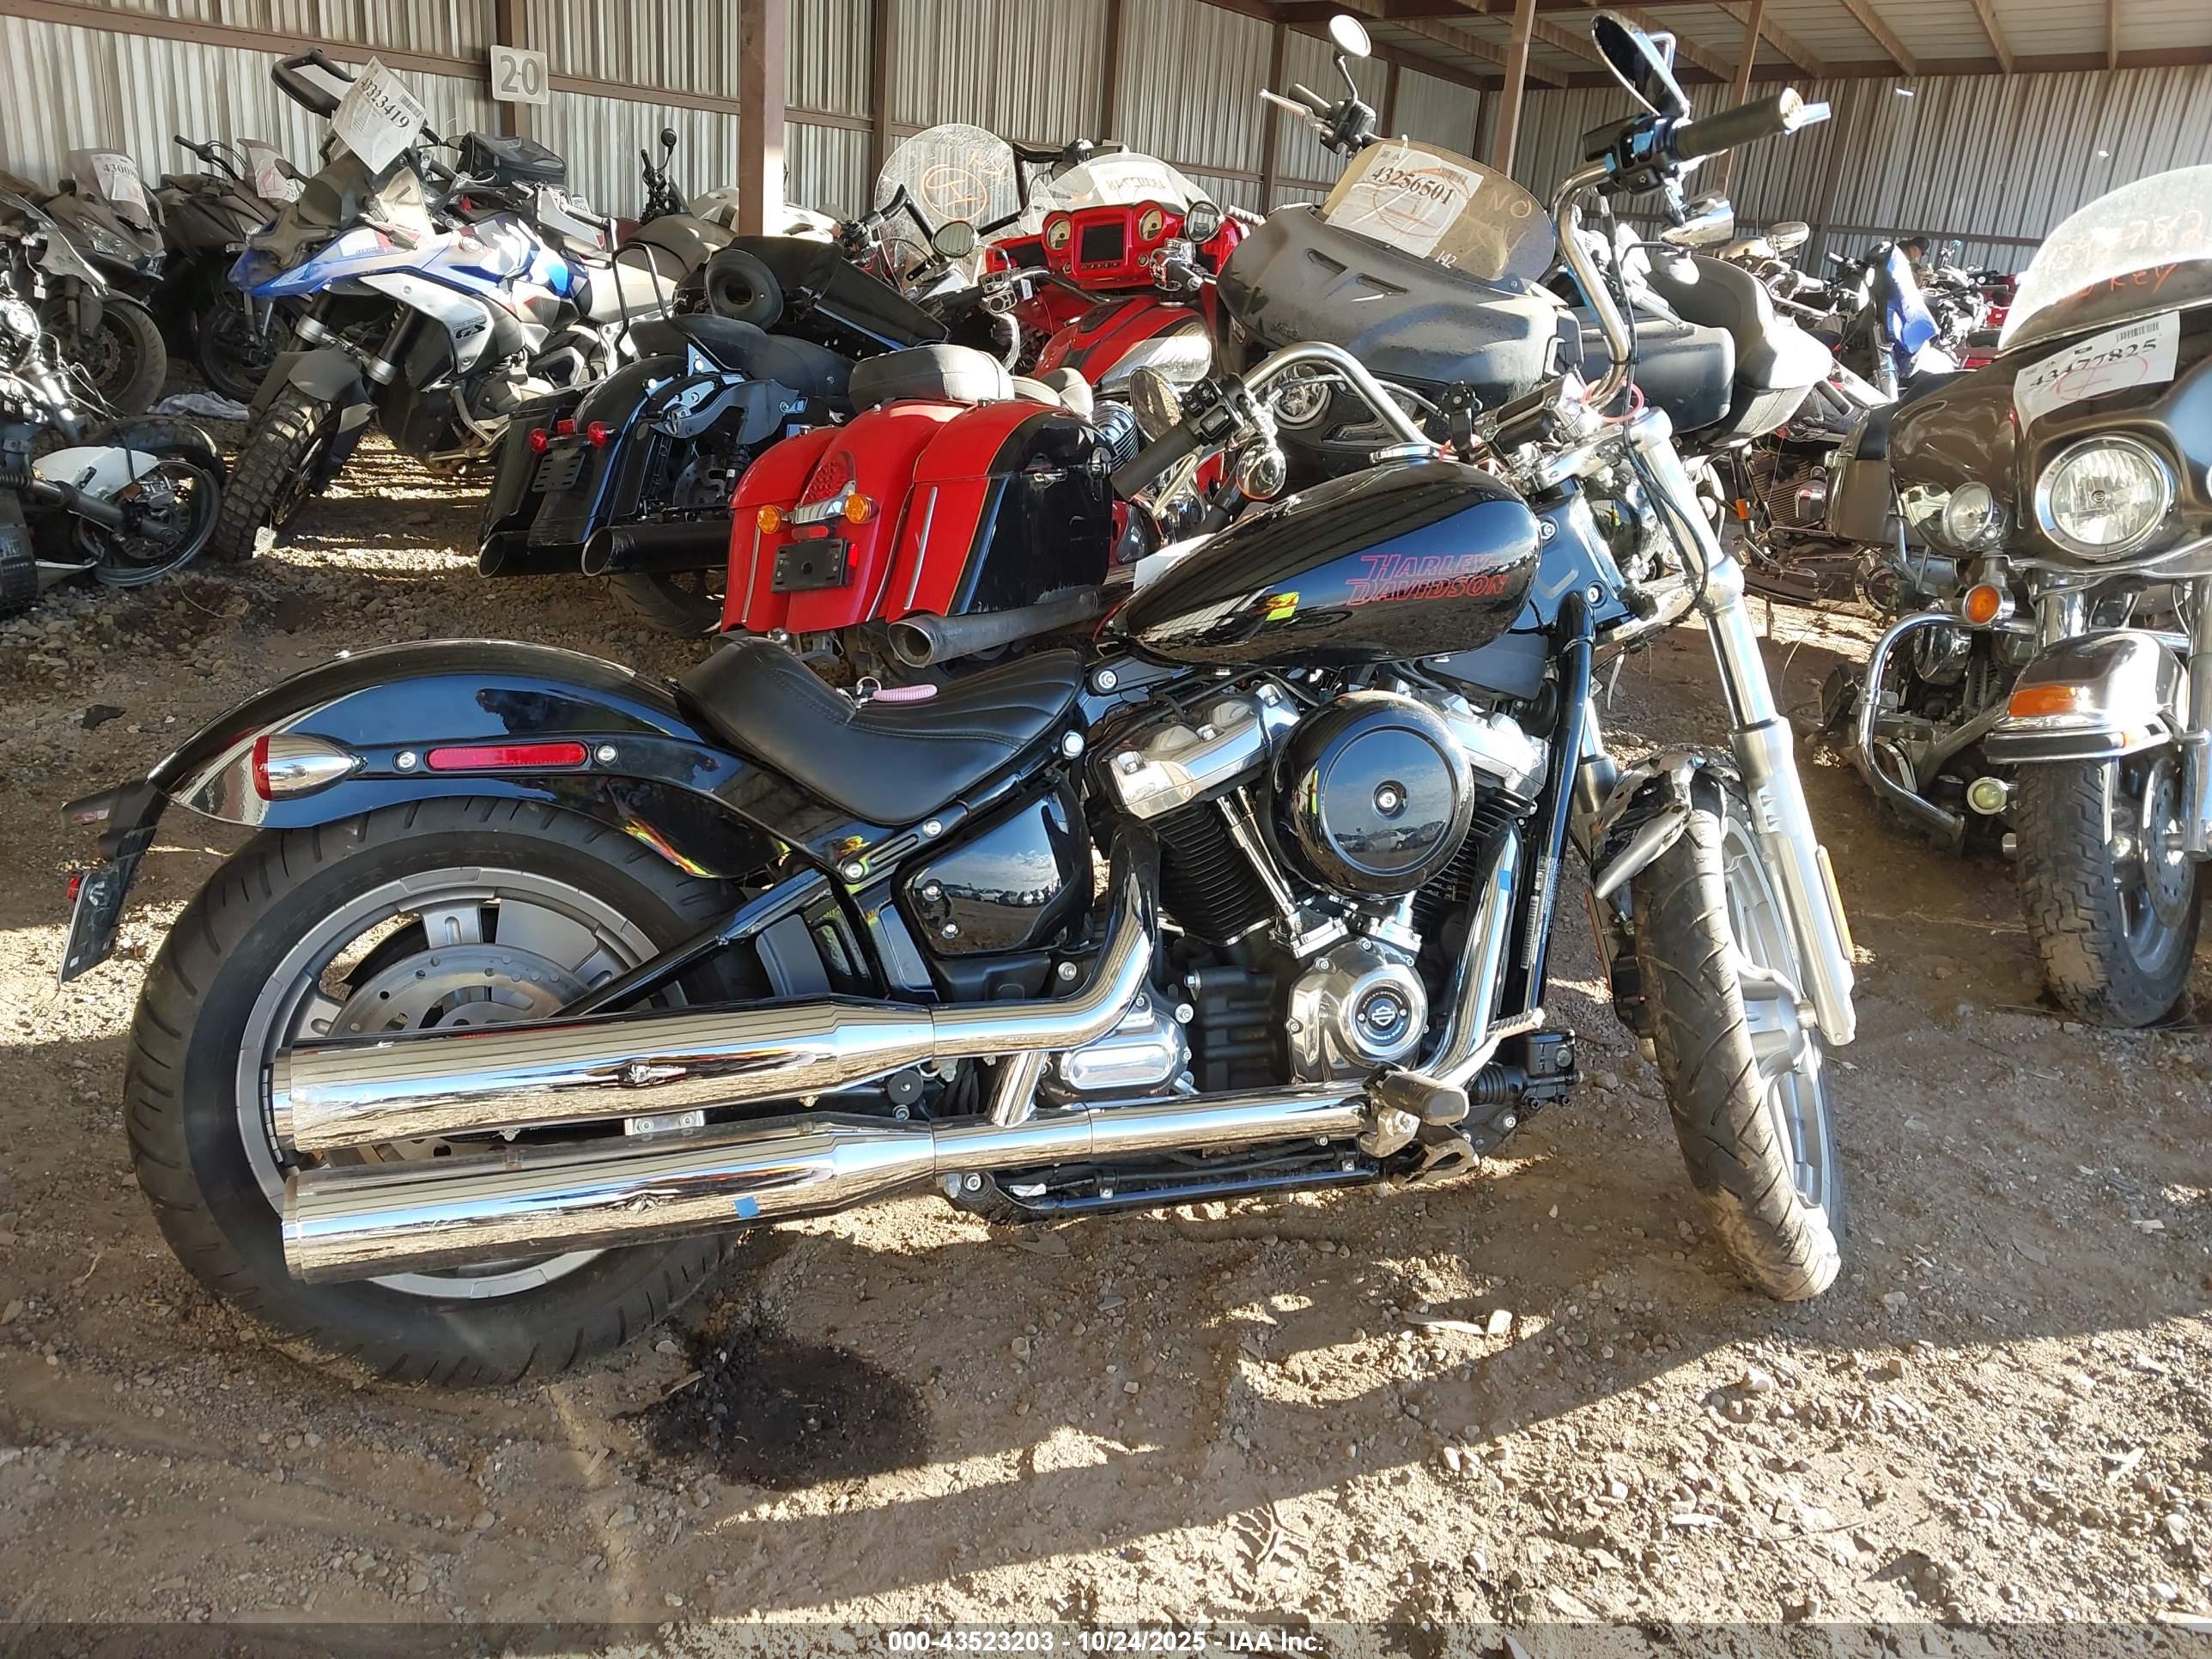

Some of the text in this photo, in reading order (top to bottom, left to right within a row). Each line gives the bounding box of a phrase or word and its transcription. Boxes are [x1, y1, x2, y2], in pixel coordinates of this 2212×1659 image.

[500, 54, 540, 96] 20
[361, 76, 410, 128] 43323419
[1371, 165, 1454, 206] 43256501
[1486, 190, 1534, 219] NO
[1346, 574, 1510, 606] DAVIDSON
